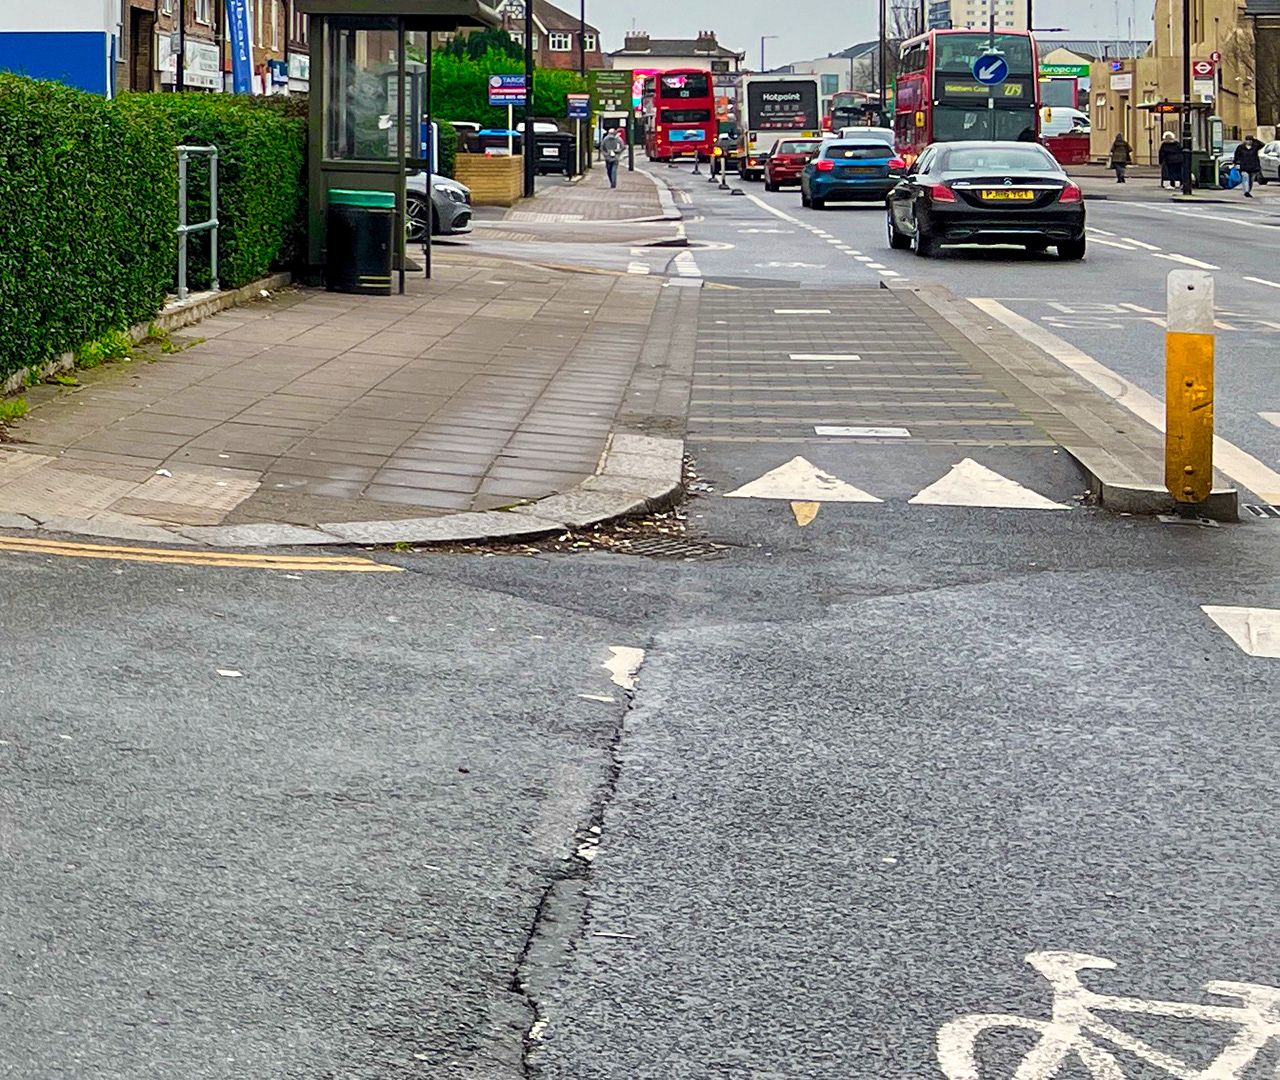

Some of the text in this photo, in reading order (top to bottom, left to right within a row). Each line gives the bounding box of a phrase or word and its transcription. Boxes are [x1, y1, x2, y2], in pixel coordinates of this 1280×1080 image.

[1212, 52, 1218, 60] E
[1039, 65, 1082, 75] Europcar
[1004, 83, 1023, 96] 279
[762, 92, 800, 102] Hotpoint
